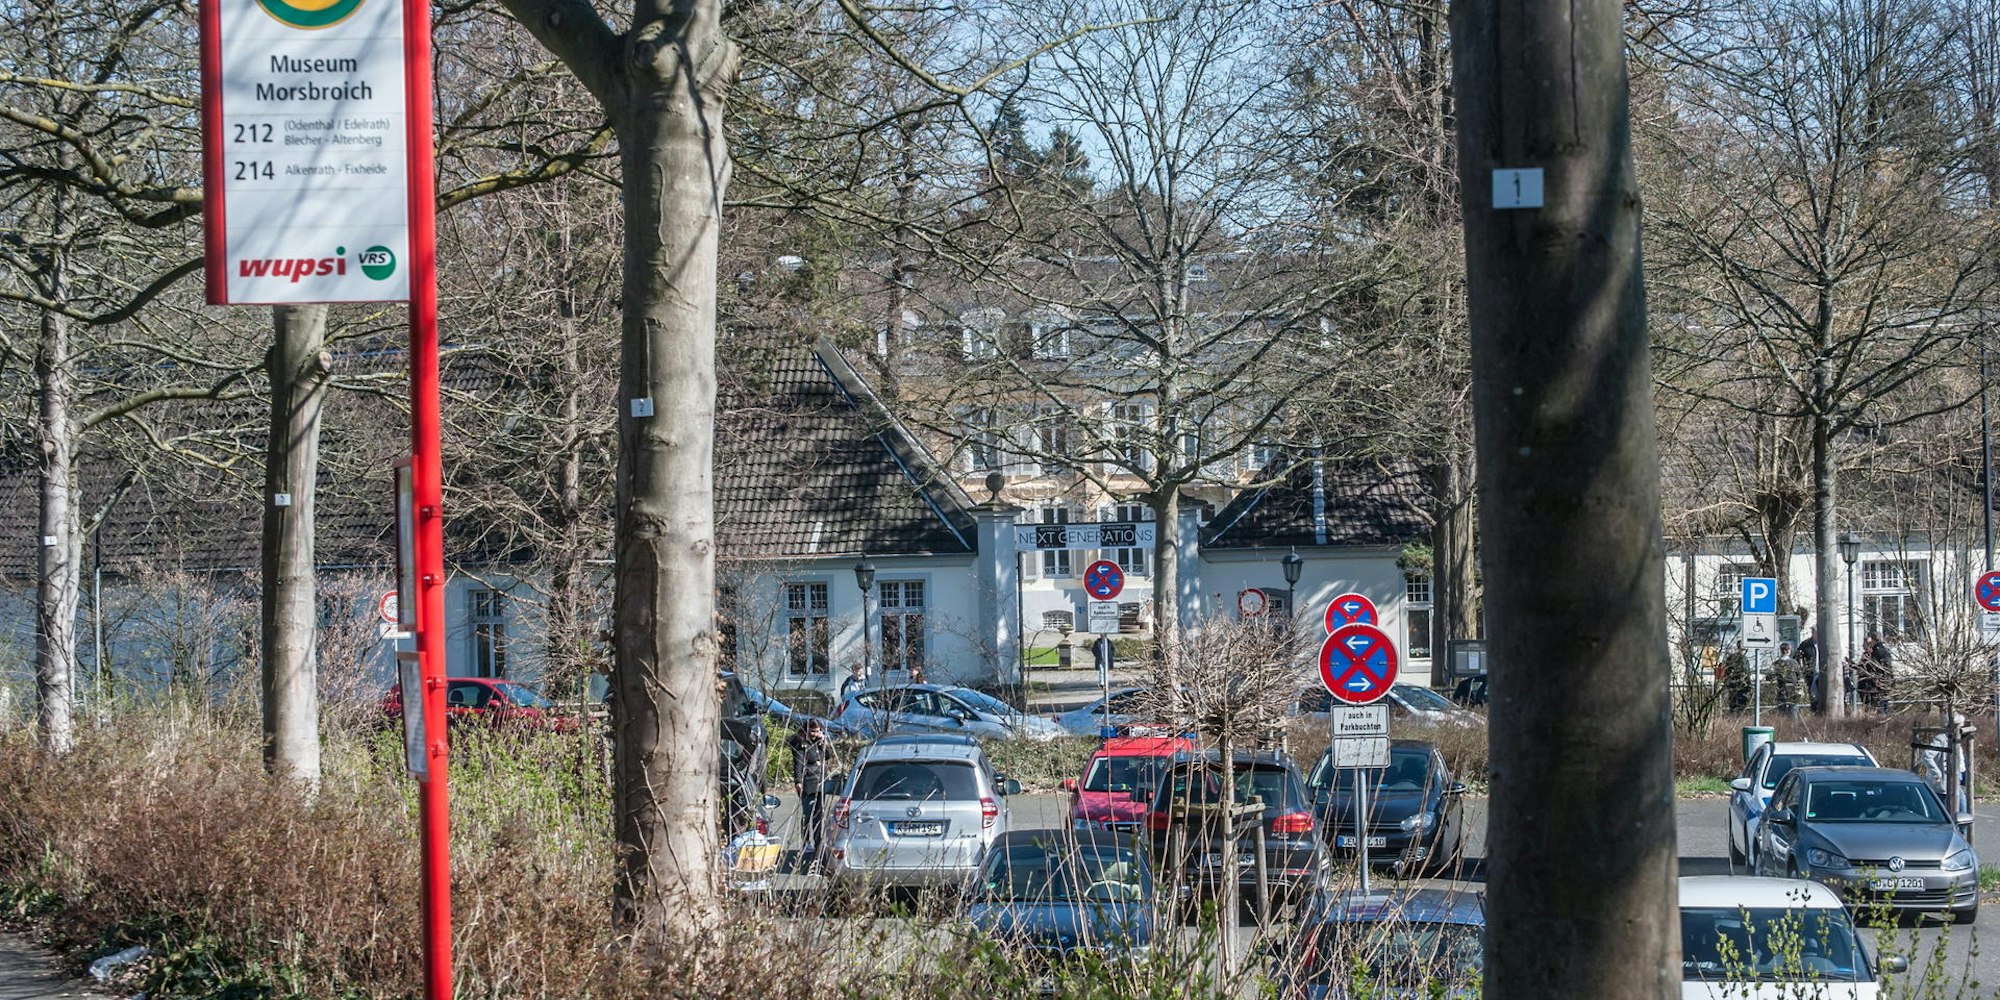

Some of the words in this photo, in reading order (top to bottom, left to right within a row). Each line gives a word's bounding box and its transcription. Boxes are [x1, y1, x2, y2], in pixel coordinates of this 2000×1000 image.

[270, 55, 358, 73] Museum
[256, 81, 373, 101] Morsbroich
[234, 123, 274, 143] 212
[284, 119, 334, 132] (Odenthal
[344, 118, 390, 131] Edelrath)
[284, 134, 322, 145] Blecher
[332, 134, 382, 147] Altenberg
[234, 160, 275, 180] 214
[285, 163, 335, 175] Alkenrath
[344, 163, 388, 175] Fixheide
[239, 246, 346, 283] wupsi
[358, 252, 386, 264] VRS
[1019, 531, 1056, 544] NEXT
[1057, 529, 1153, 544] GENERATIONS
[1750, 582, 1769, 609] P
[1348, 711, 1364, 719] auch
[1365, 711, 1373, 719] in
[1340, 723, 1382, 731] Parkbuchten
